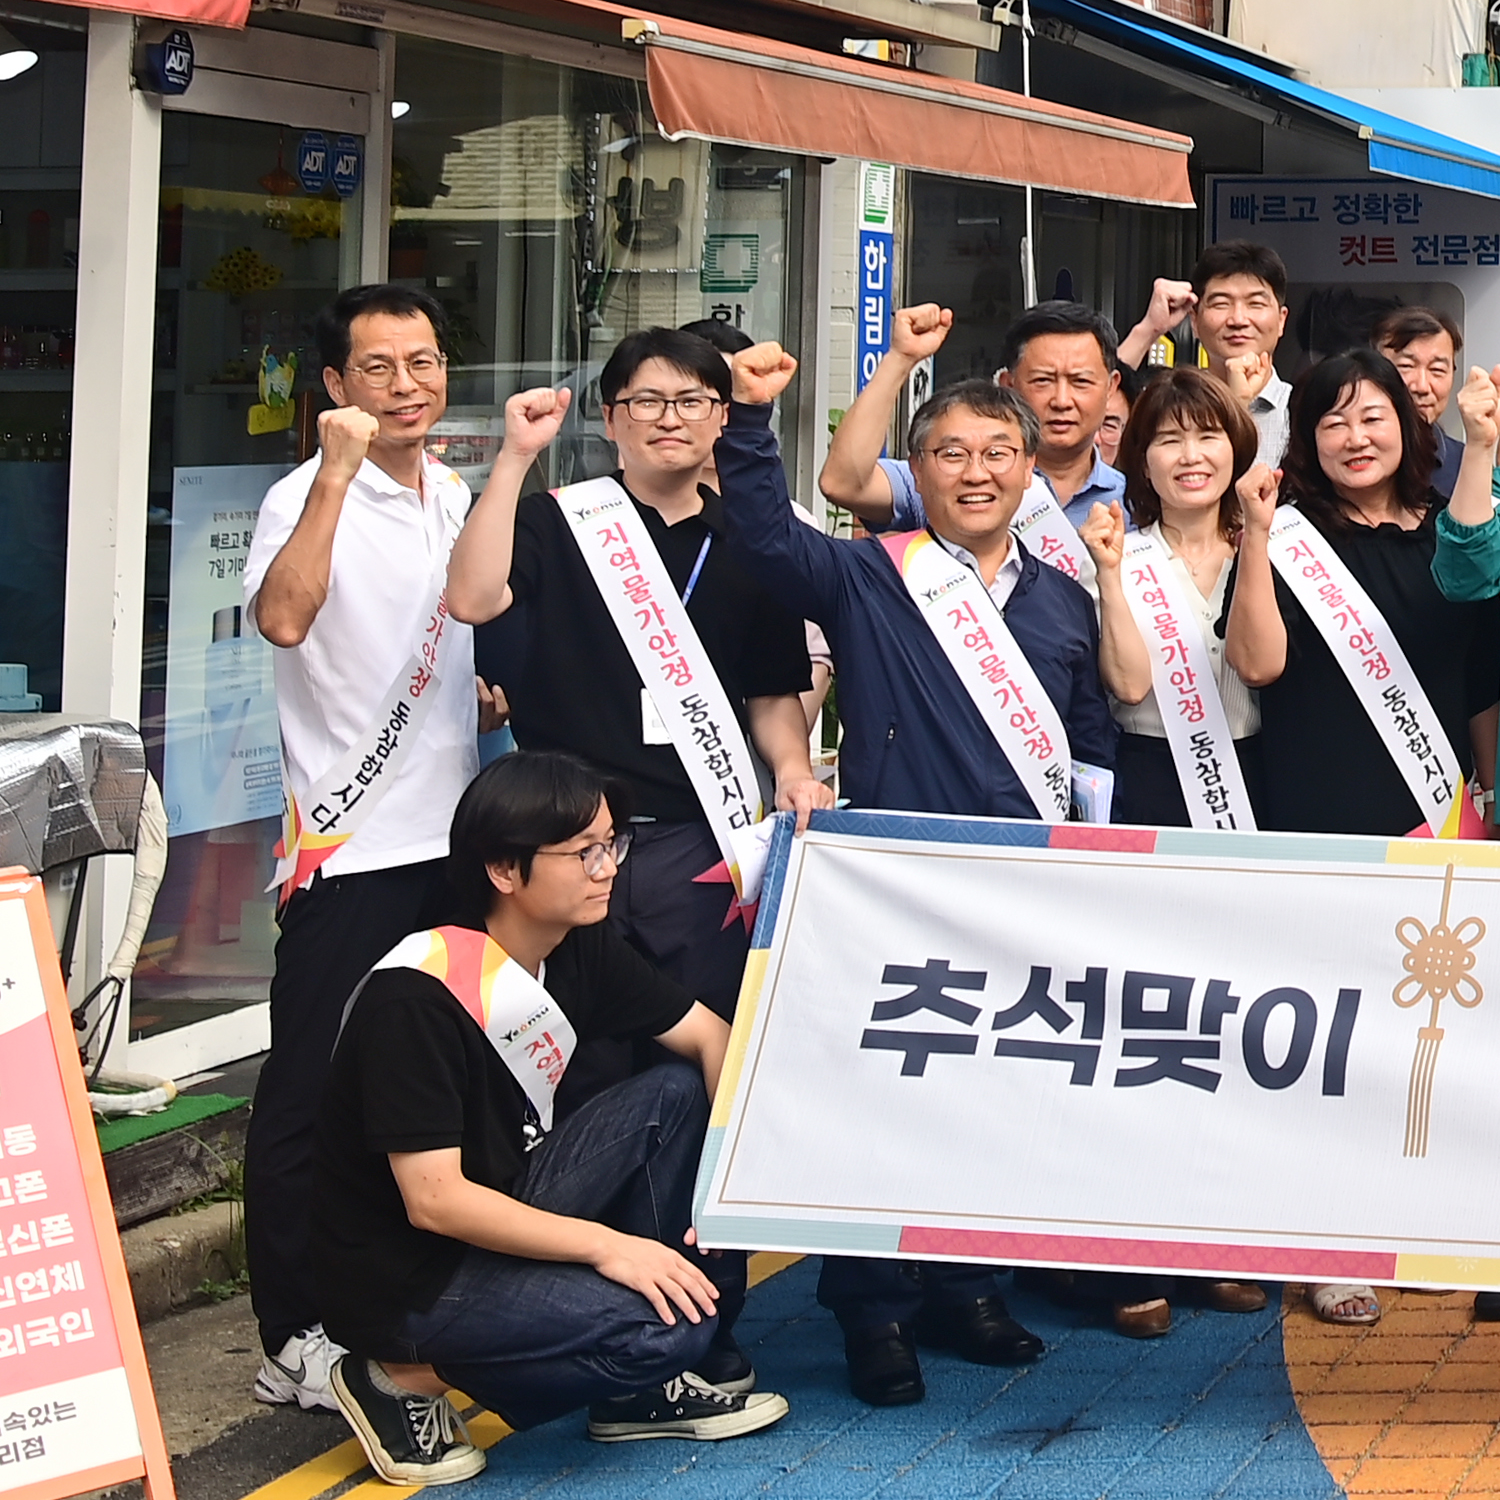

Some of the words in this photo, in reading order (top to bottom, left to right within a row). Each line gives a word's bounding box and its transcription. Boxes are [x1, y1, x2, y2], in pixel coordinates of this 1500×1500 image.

[165, 51, 191, 74] ADT
[302, 151, 326, 173] ADT
[335, 155, 357, 176] ADT
[1228, 196, 1319, 225] 빠르고
[1332, 192, 1423, 226] 정확한
[1338, 233, 1398, 266] 컷트
[1410, 233, 1500, 266] 전문점
[572, 497, 624, 521] Yeonsu
[210, 531, 240, 553] 빠르고
[208, 557, 225, 579] 7일
[920, 573, 968, 604] Yeonsu
[1130, 565, 1205, 724] 지역물가안정
[596, 521, 694, 688] 지역물가안정
[679, 693, 753, 831] 동참합시다
[946, 600, 1054, 761] 지역물가안정
[1286, 540, 1393, 682] 지역물가안정
[1380, 683, 1454, 807] 동참합시다
[309, 699, 411, 835] 동참합시다
[500, 1004, 551, 1044] Yeonsu
[857, 955, 1362, 1100] 추석맞이
